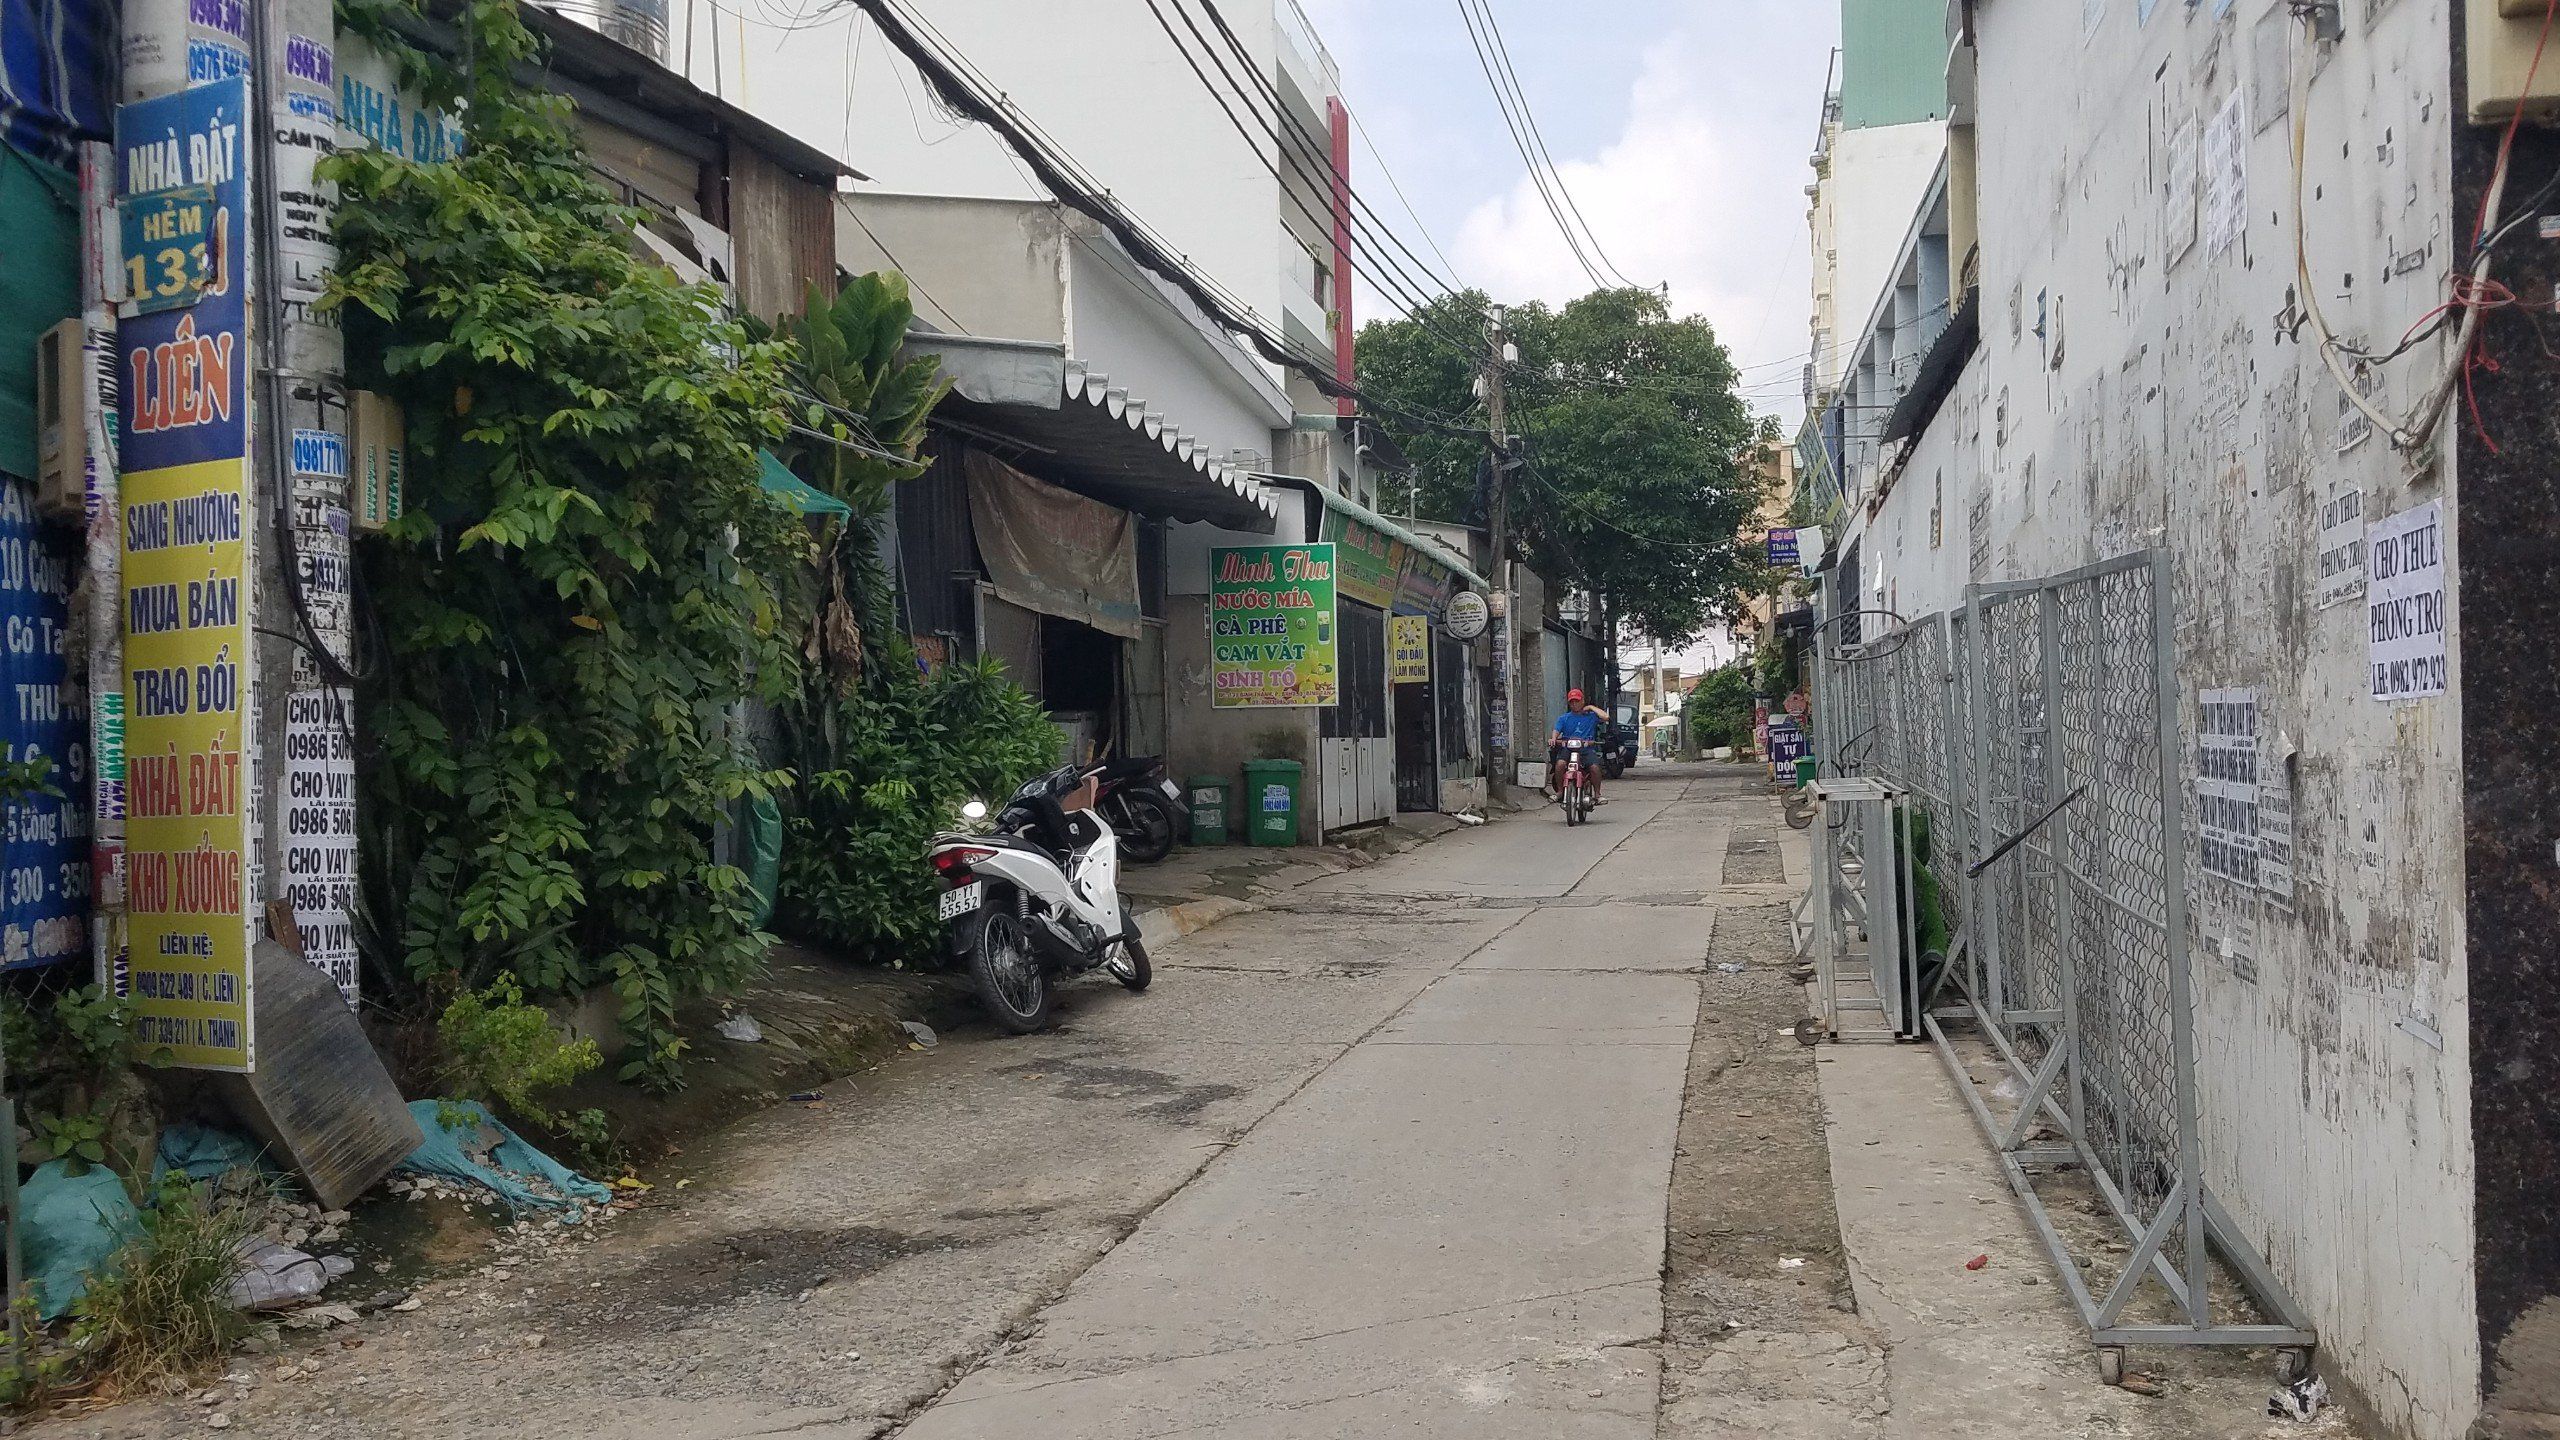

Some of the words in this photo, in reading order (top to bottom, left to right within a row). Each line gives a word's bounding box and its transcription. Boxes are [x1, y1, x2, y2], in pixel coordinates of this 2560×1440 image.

[129, 126, 183, 195] NHÀ
[190, 105, 236, 186] ĐẤT
[144, 200, 201, 241] HẺM
[125, 242, 206, 300] 133
[131, 314, 233, 432] LIÊN
[127, 502, 168, 551] SANG
[174, 490, 240, 554] NHƯỢNG
[2374, 536, 2399, 581] CHO
[2402, 510, 2437, 574] THUÊ
[1215, 552, 1275, 583] Minh
[1282, 550, 1331, 582] Thu
[130, 583, 180, 634] MUA
[188, 569, 237, 629] BÁN
[1215, 588, 1271, 610] NƯỚC
[1275, 587, 1314, 608] MÍA
[1215, 615, 1244, 636] CÀ
[1247, 613, 1287, 635] PHÊ
[2371, 588, 2413, 643] PHÒNG
[2415, 588, 2443, 643] TRỌ
[7, 614, 34, 653] Có
[40, 617, 65, 655] Ta
[1216, 644, 1259, 662] CAM
[1264, 637, 1306, 661] VẮT
[133, 666, 188, 717] TRAO
[196, 644, 236, 713] ĐỔI
[1217, 671, 1263, 688] SINH
[1270, 664, 1296, 687] TỐ
[2373, 662, 2388, 695] LH:
[2390, 658, 2410, 693] 0982
[2412, 660, 2428, 691] 972
[2430, 653, 2446, 691] 923
[289, 698, 320, 724] CHO
[288, 733, 327, 761] 0986
[1775, 731, 1789, 745] GIẶT
[1783, 744, 1797, 757] TỰ
[130, 742, 182, 818] NHÀ
[189, 730, 239, 816] ĐẤT
[1776, 759, 1797, 774] ĐỘN
[290, 771, 323, 799] CHO
[326, 773, 347, 799] VAY
[289, 807, 328, 835] 0986
[332, 808, 350, 835] 506
[130, 851, 168, 914] KHO
[174, 829, 240, 916] XƯỞNG
[288, 847, 321, 875] CHO
[326, 848, 347, 874] VAY
[10, 866, 43, 906] 300
[287, 884, 326, 911] 0986
[945, 885, 973, 904] 50-Y1
[941, 896, 977, 918] 555.52
[160, 931, 188, 955] LIÊN
[192, 932, 213, 960] HỆ:
[299, 924, 320, 951] HO
[325, 924, 348, 950] VAY
[331, 959, 351, 986] 506
